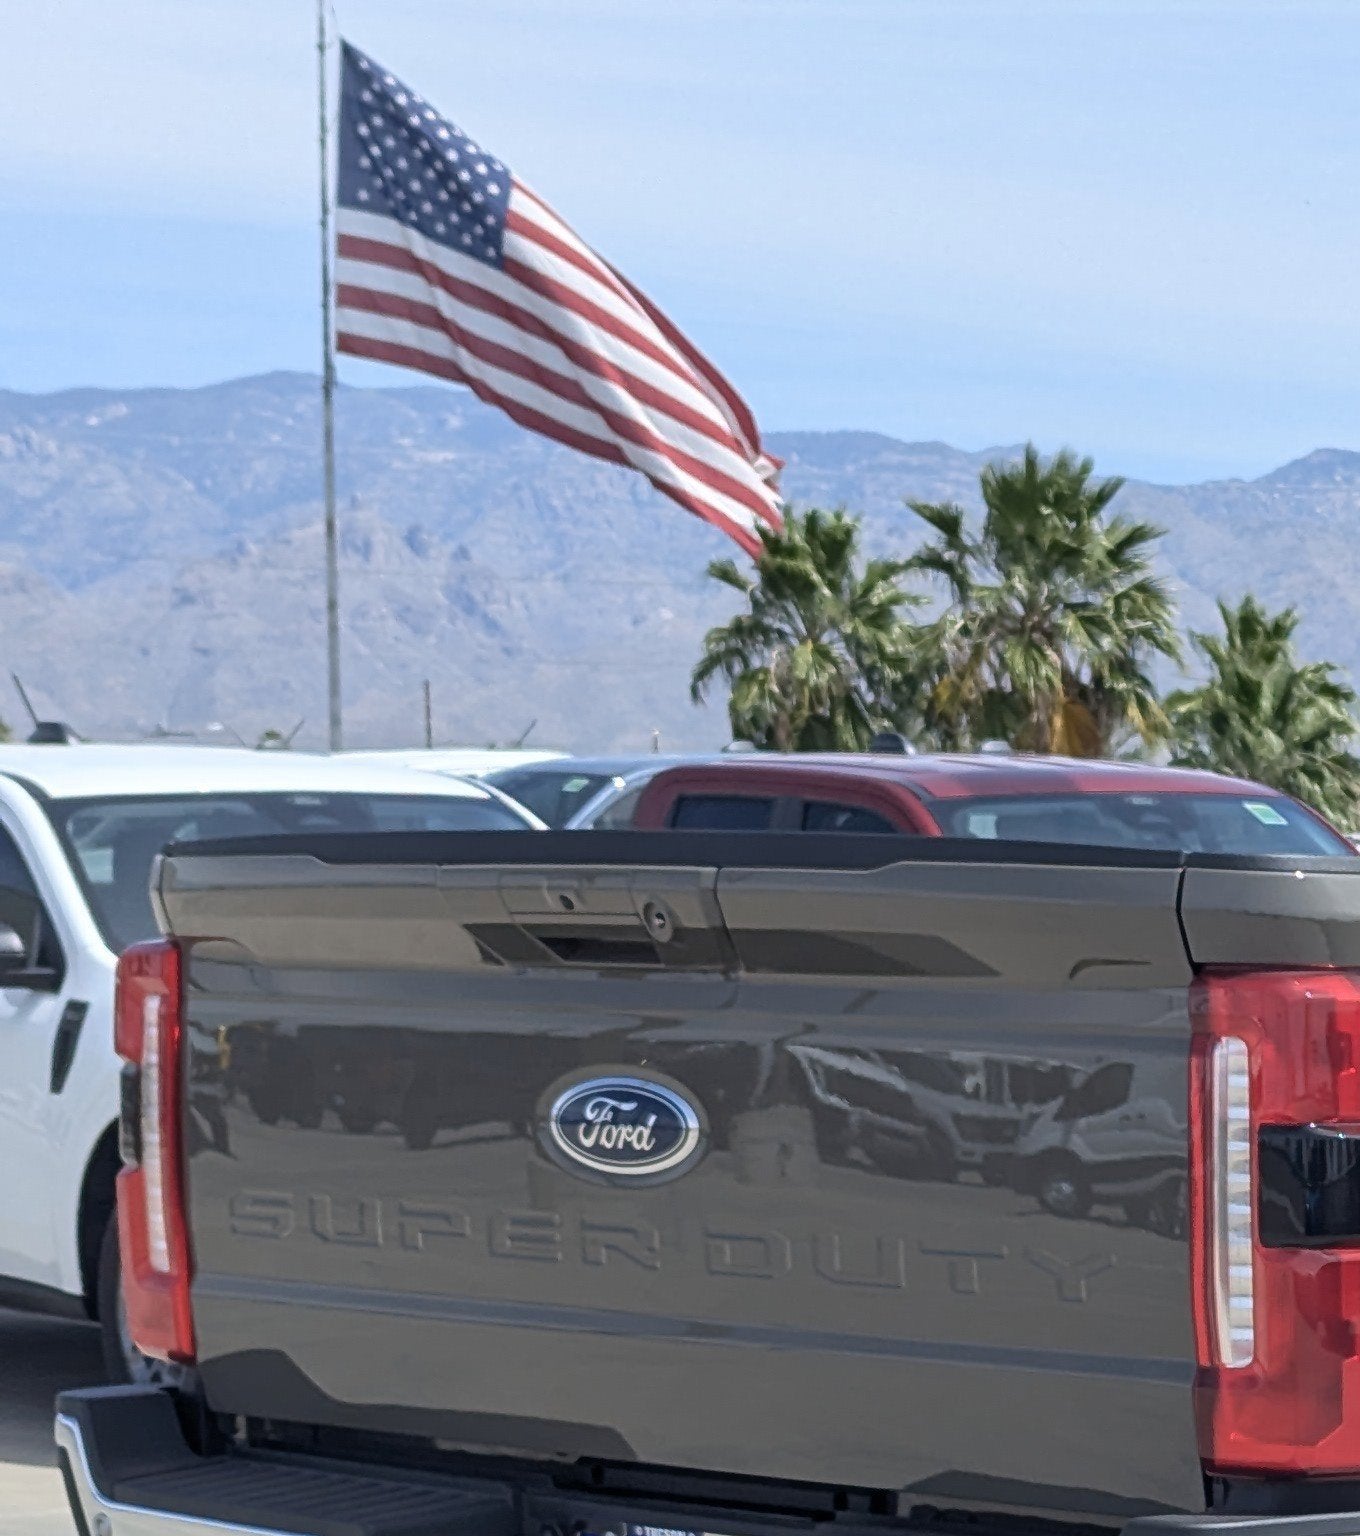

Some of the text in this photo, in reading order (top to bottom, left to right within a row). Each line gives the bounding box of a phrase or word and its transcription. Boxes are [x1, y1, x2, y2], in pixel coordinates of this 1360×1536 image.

[579, 1096, 658, 1151] Ford
[227, 1188, 1119, 1304] SUPER DUTY
